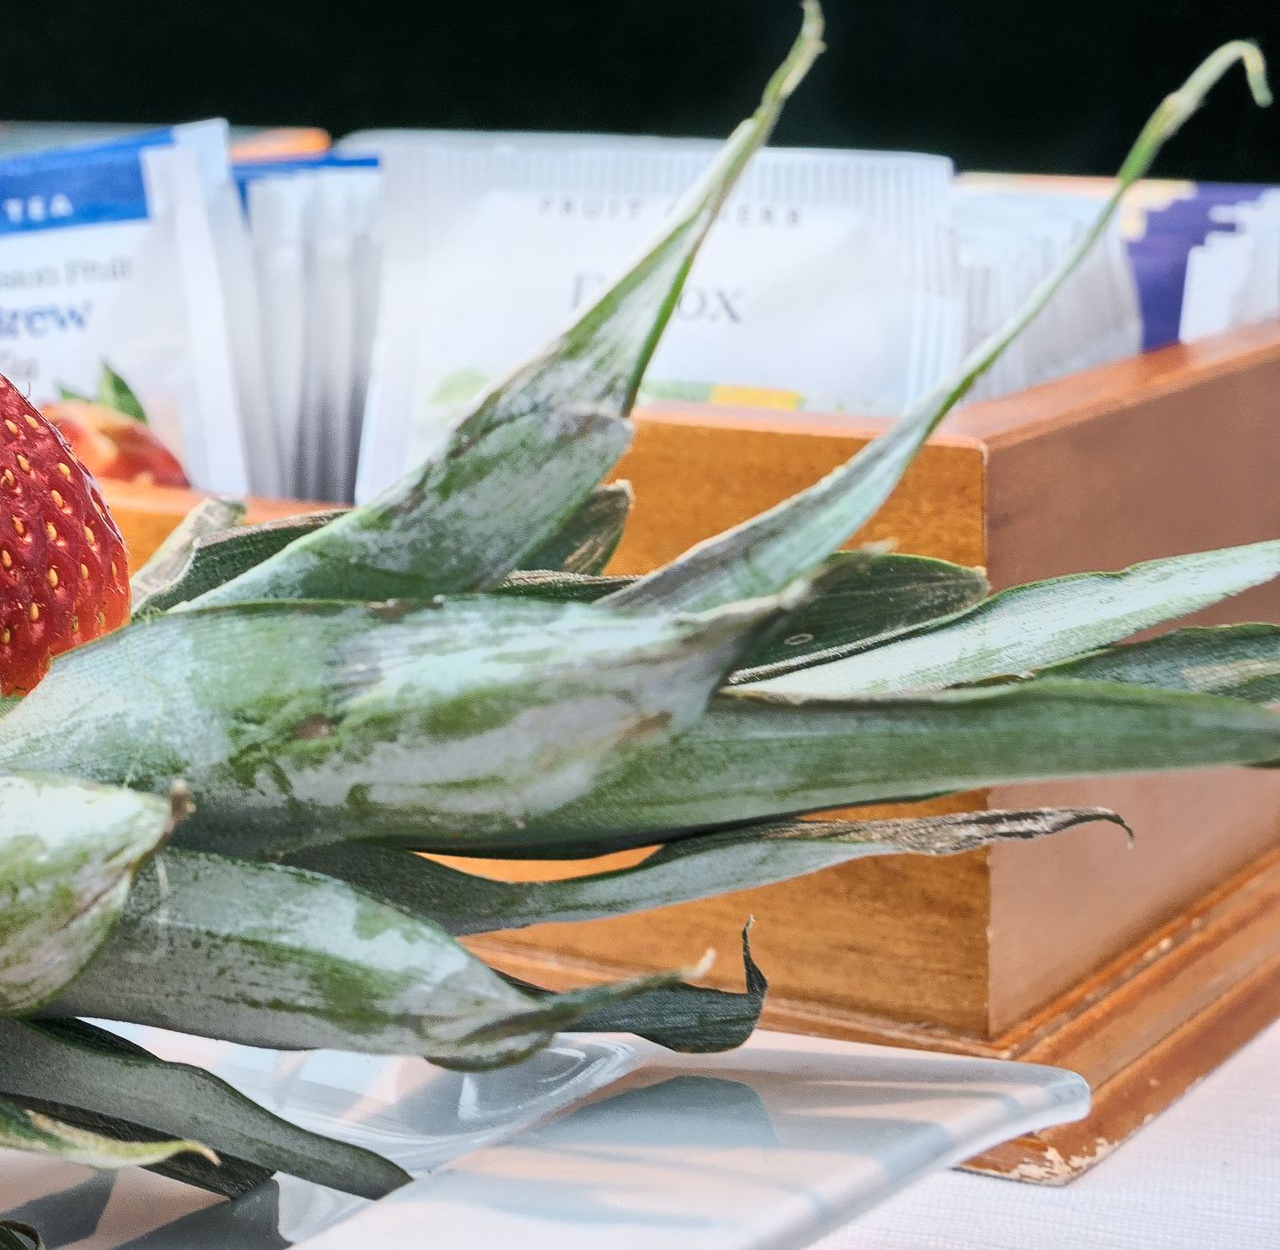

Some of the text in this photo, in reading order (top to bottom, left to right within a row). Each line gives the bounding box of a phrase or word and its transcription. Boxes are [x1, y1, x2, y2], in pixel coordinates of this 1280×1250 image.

[2, 193, 74, 224] TEA
[538, 194, 644, 220] FRUIT
[64, 255, 134, 285] Fruit
[568, 270, 746, 324] DOX
